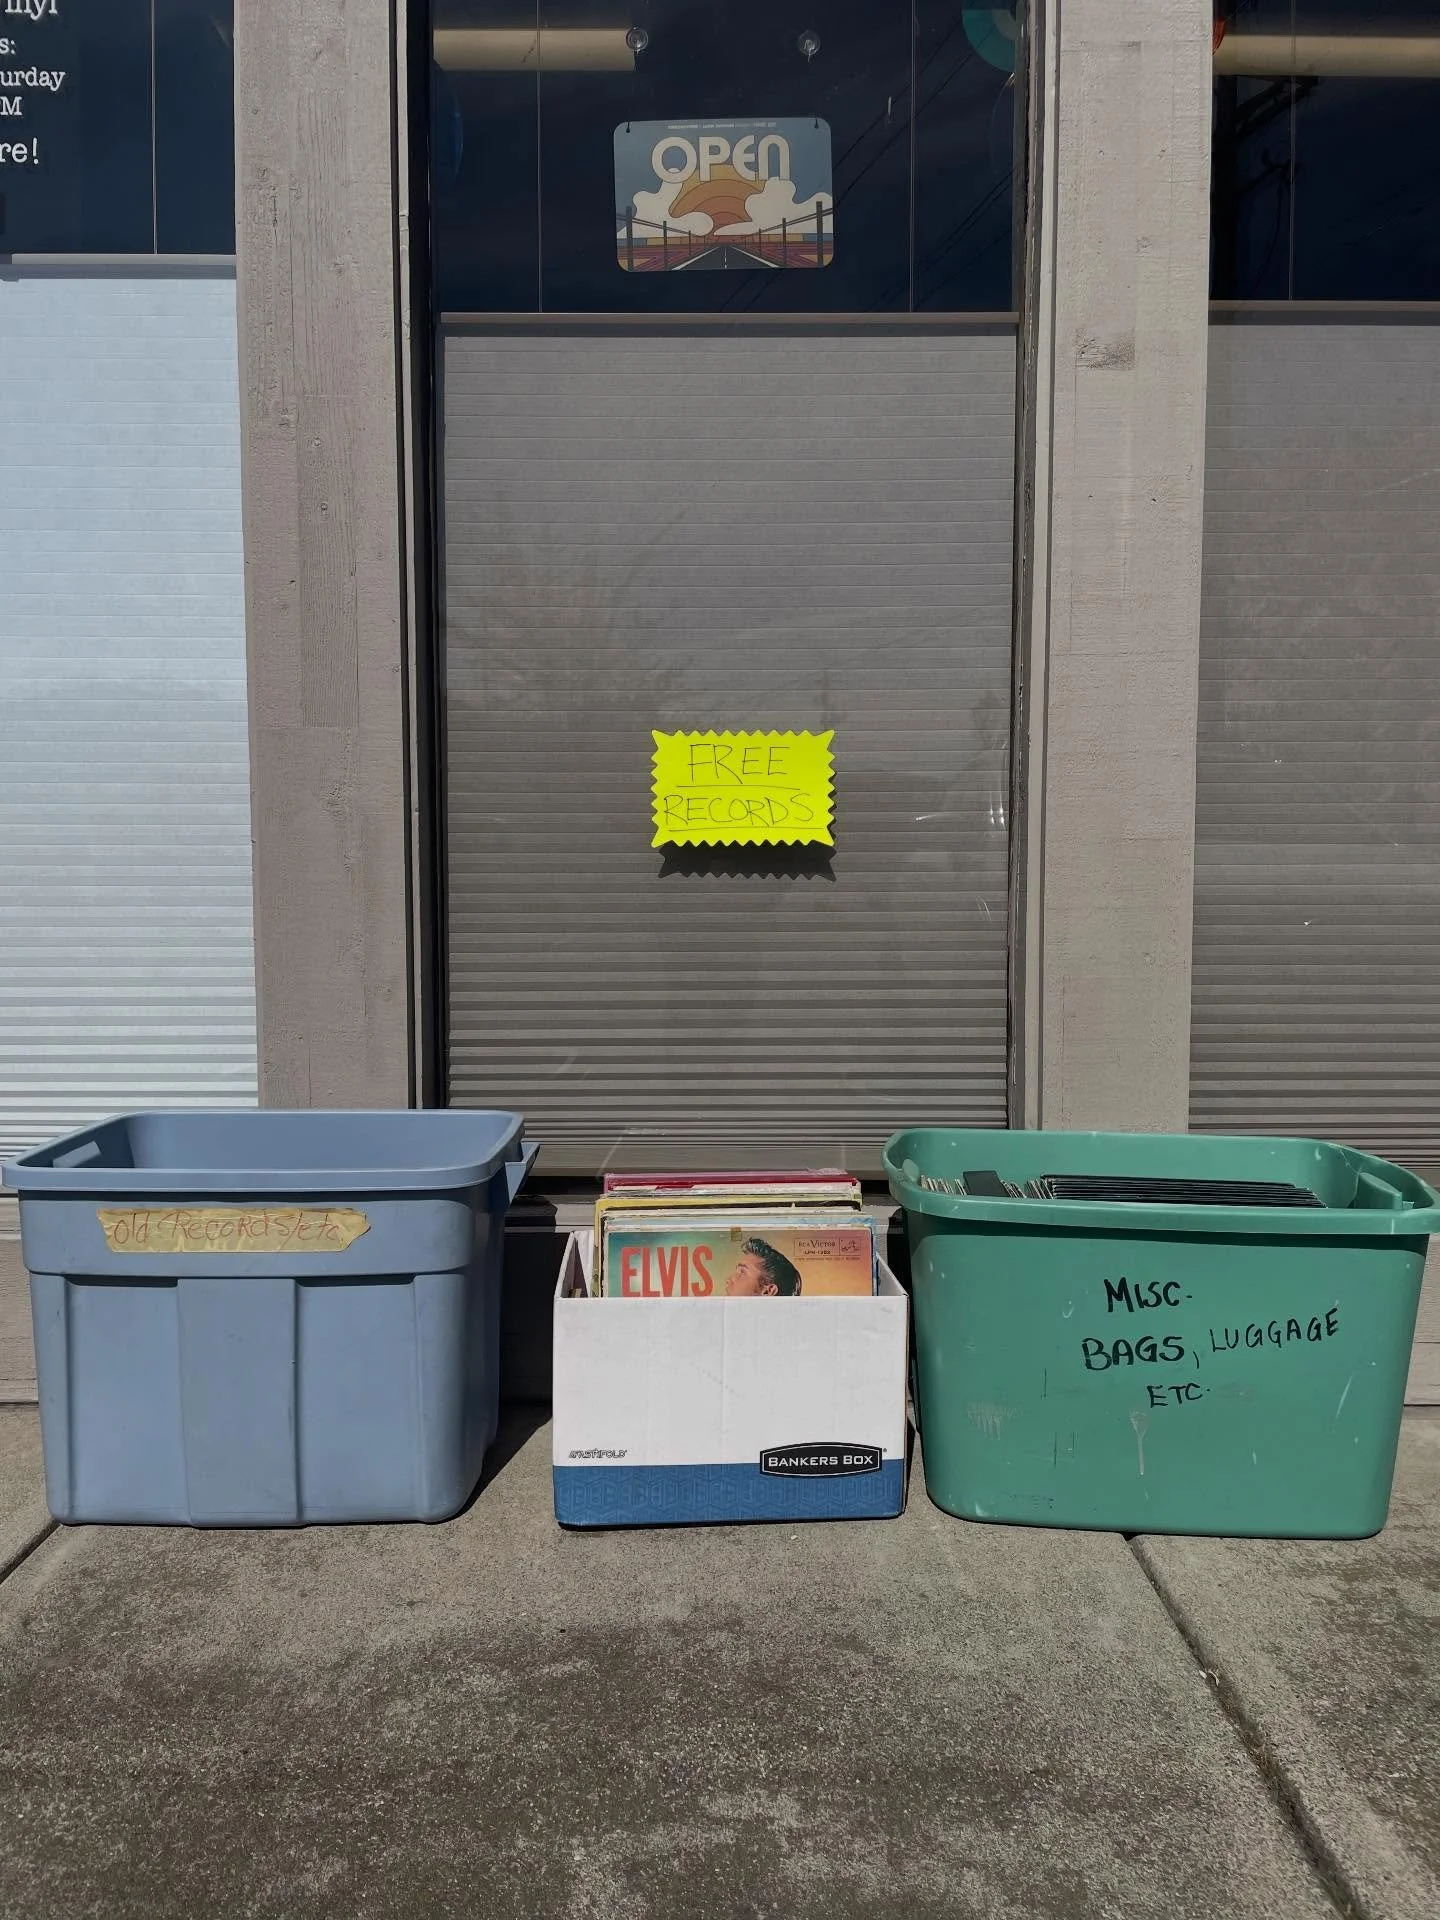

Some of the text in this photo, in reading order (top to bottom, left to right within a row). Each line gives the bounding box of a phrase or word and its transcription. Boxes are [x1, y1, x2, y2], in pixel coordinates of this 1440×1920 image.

[0, 66, 66, 92] urday
[0, 137, 39, 165] re!
[652, 134, 790, 183] OPEN
[688, 743, 790, 784] FREE
[663, 793, 815, 827] RECORDS
[620, 1245, 713, 1297] ELVIS
[1081, 1307, 1340, 1371] BAGS, LUGGAGE
[768, 1455, 874, 1467] BANKERS BOX
